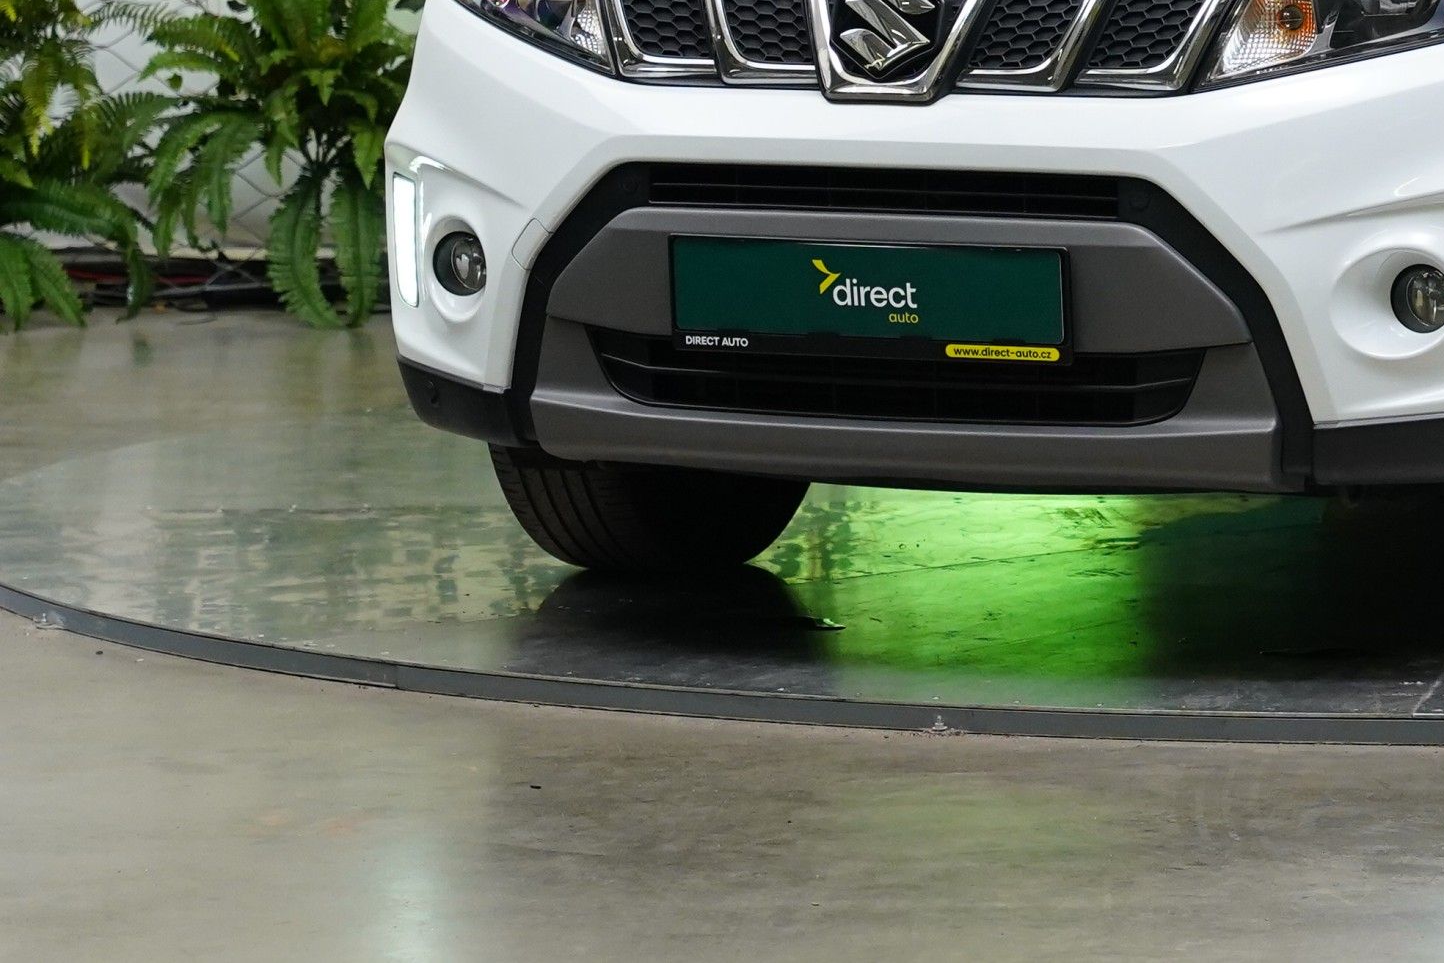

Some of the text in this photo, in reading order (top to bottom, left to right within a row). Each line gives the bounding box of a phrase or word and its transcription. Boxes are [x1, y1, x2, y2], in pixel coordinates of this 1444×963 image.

[832, 278, 918, 309] direct
[888, 312, 919, 324] auto
[685, 335, 749, 347] DIRECT AUTO
[953, 347, 1052, 359] www.direct-auto.cz
